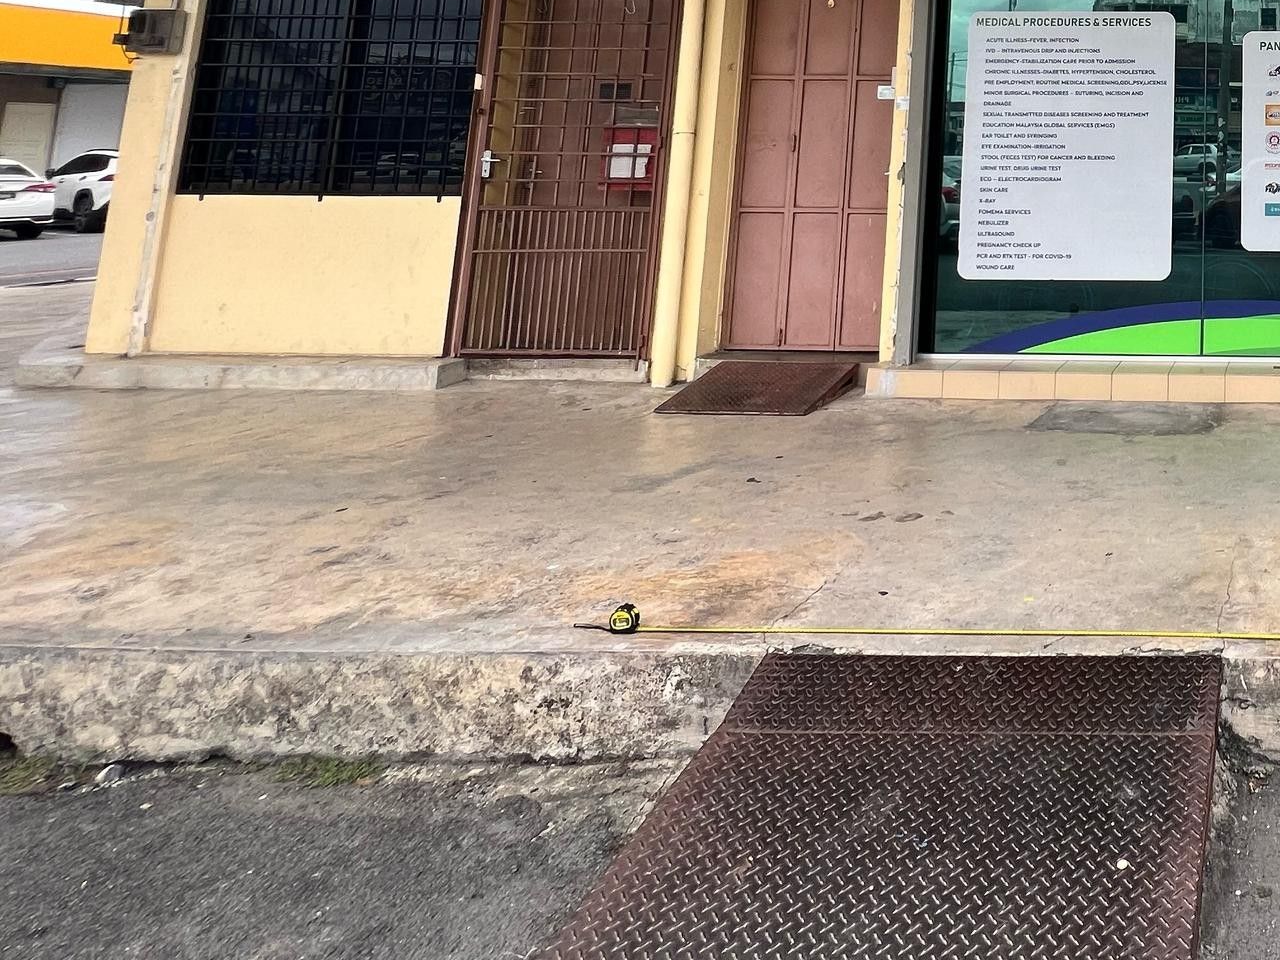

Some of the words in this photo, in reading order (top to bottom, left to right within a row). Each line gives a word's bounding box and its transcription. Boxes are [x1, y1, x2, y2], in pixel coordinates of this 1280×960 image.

[976, 18, 1021, 27] MEDICAL
[1023, 18, 1091, 27] PROCEDURES
[1093, 18, 1100, 27] &
[1102, 18, 1152, 27] SERVICES
